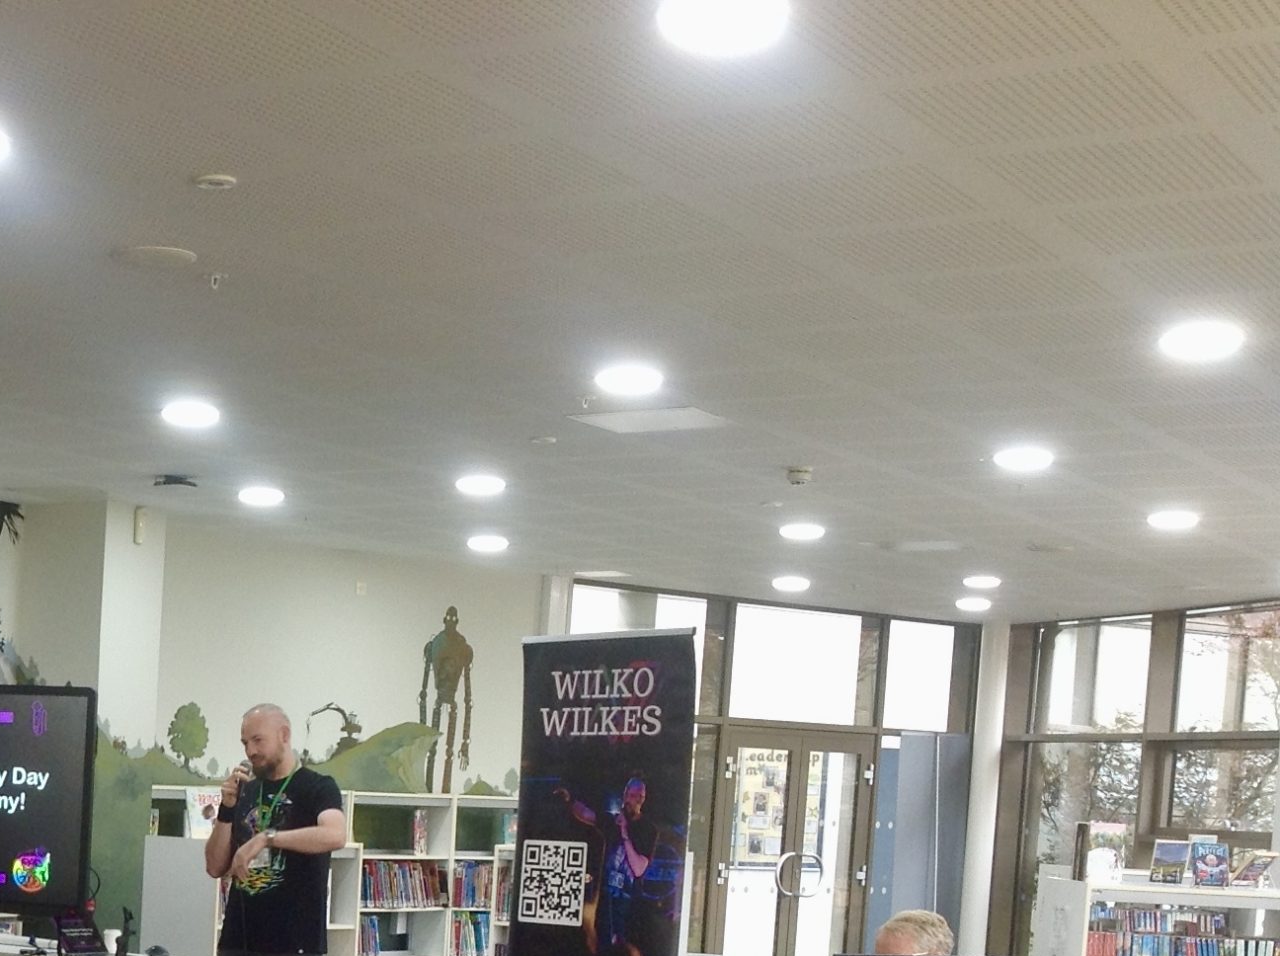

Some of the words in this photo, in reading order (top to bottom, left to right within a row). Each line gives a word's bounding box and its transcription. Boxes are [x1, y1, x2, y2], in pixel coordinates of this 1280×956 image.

[551, 667, 654, 700] WILKO
[540, 705, 662, 737] WILKES
[745, 750, 820, 767] eaderp
[12, 767, 49, 789] Day
